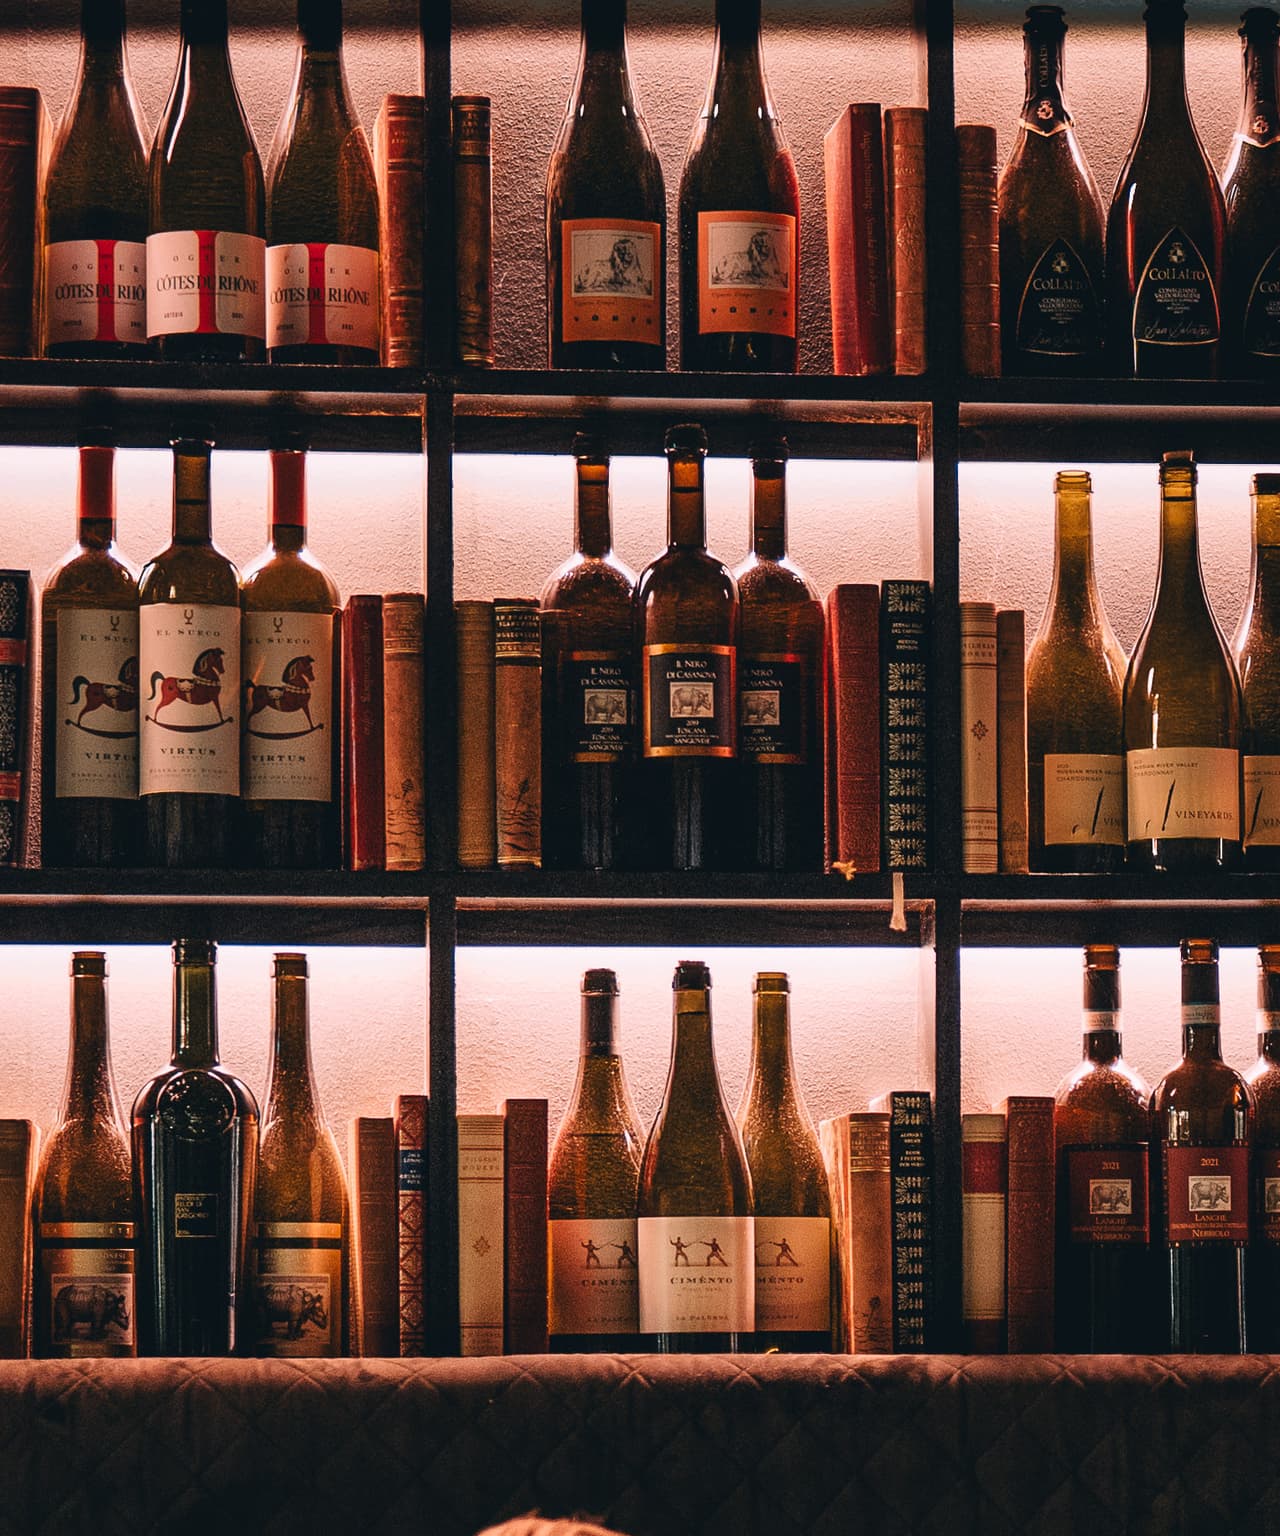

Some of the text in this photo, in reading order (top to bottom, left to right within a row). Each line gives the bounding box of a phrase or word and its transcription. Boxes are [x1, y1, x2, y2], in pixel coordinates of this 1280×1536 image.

[1149, 268, 1205, 281] COLLALTO
[156, 273, 259, 295] CÔTES DU RHÔNE
[55, 282, 94, 301] CÔTES
[95, 283, 114, 299] DU
[270, 286, 370, 306] CÔTES DU RHÔNE
[80, 633, 97, 642] EL
[156, 629, 221, 638] EL SUECO
[685, 660, 708, 669] NERO
[676, 671, 717, 680] CASANOVA
[677, 727, 707, 735] TOSCANA
[160, 747, 217, 757] VIRTUS
[251, 754, 307, 763] VIRTUS
[1175, 810, 1233, 820] VINEYARDS
[1102, 1161, 1120, 1170] 2021
[1200, 1158, 1219, 1167] 2021
[1095, 1216, 1127, 1224] LANGHE
[1195, 1213, 1227, 1222] LANGHE
[1192, 1229, 1230, 1238] NEBBIOLO
